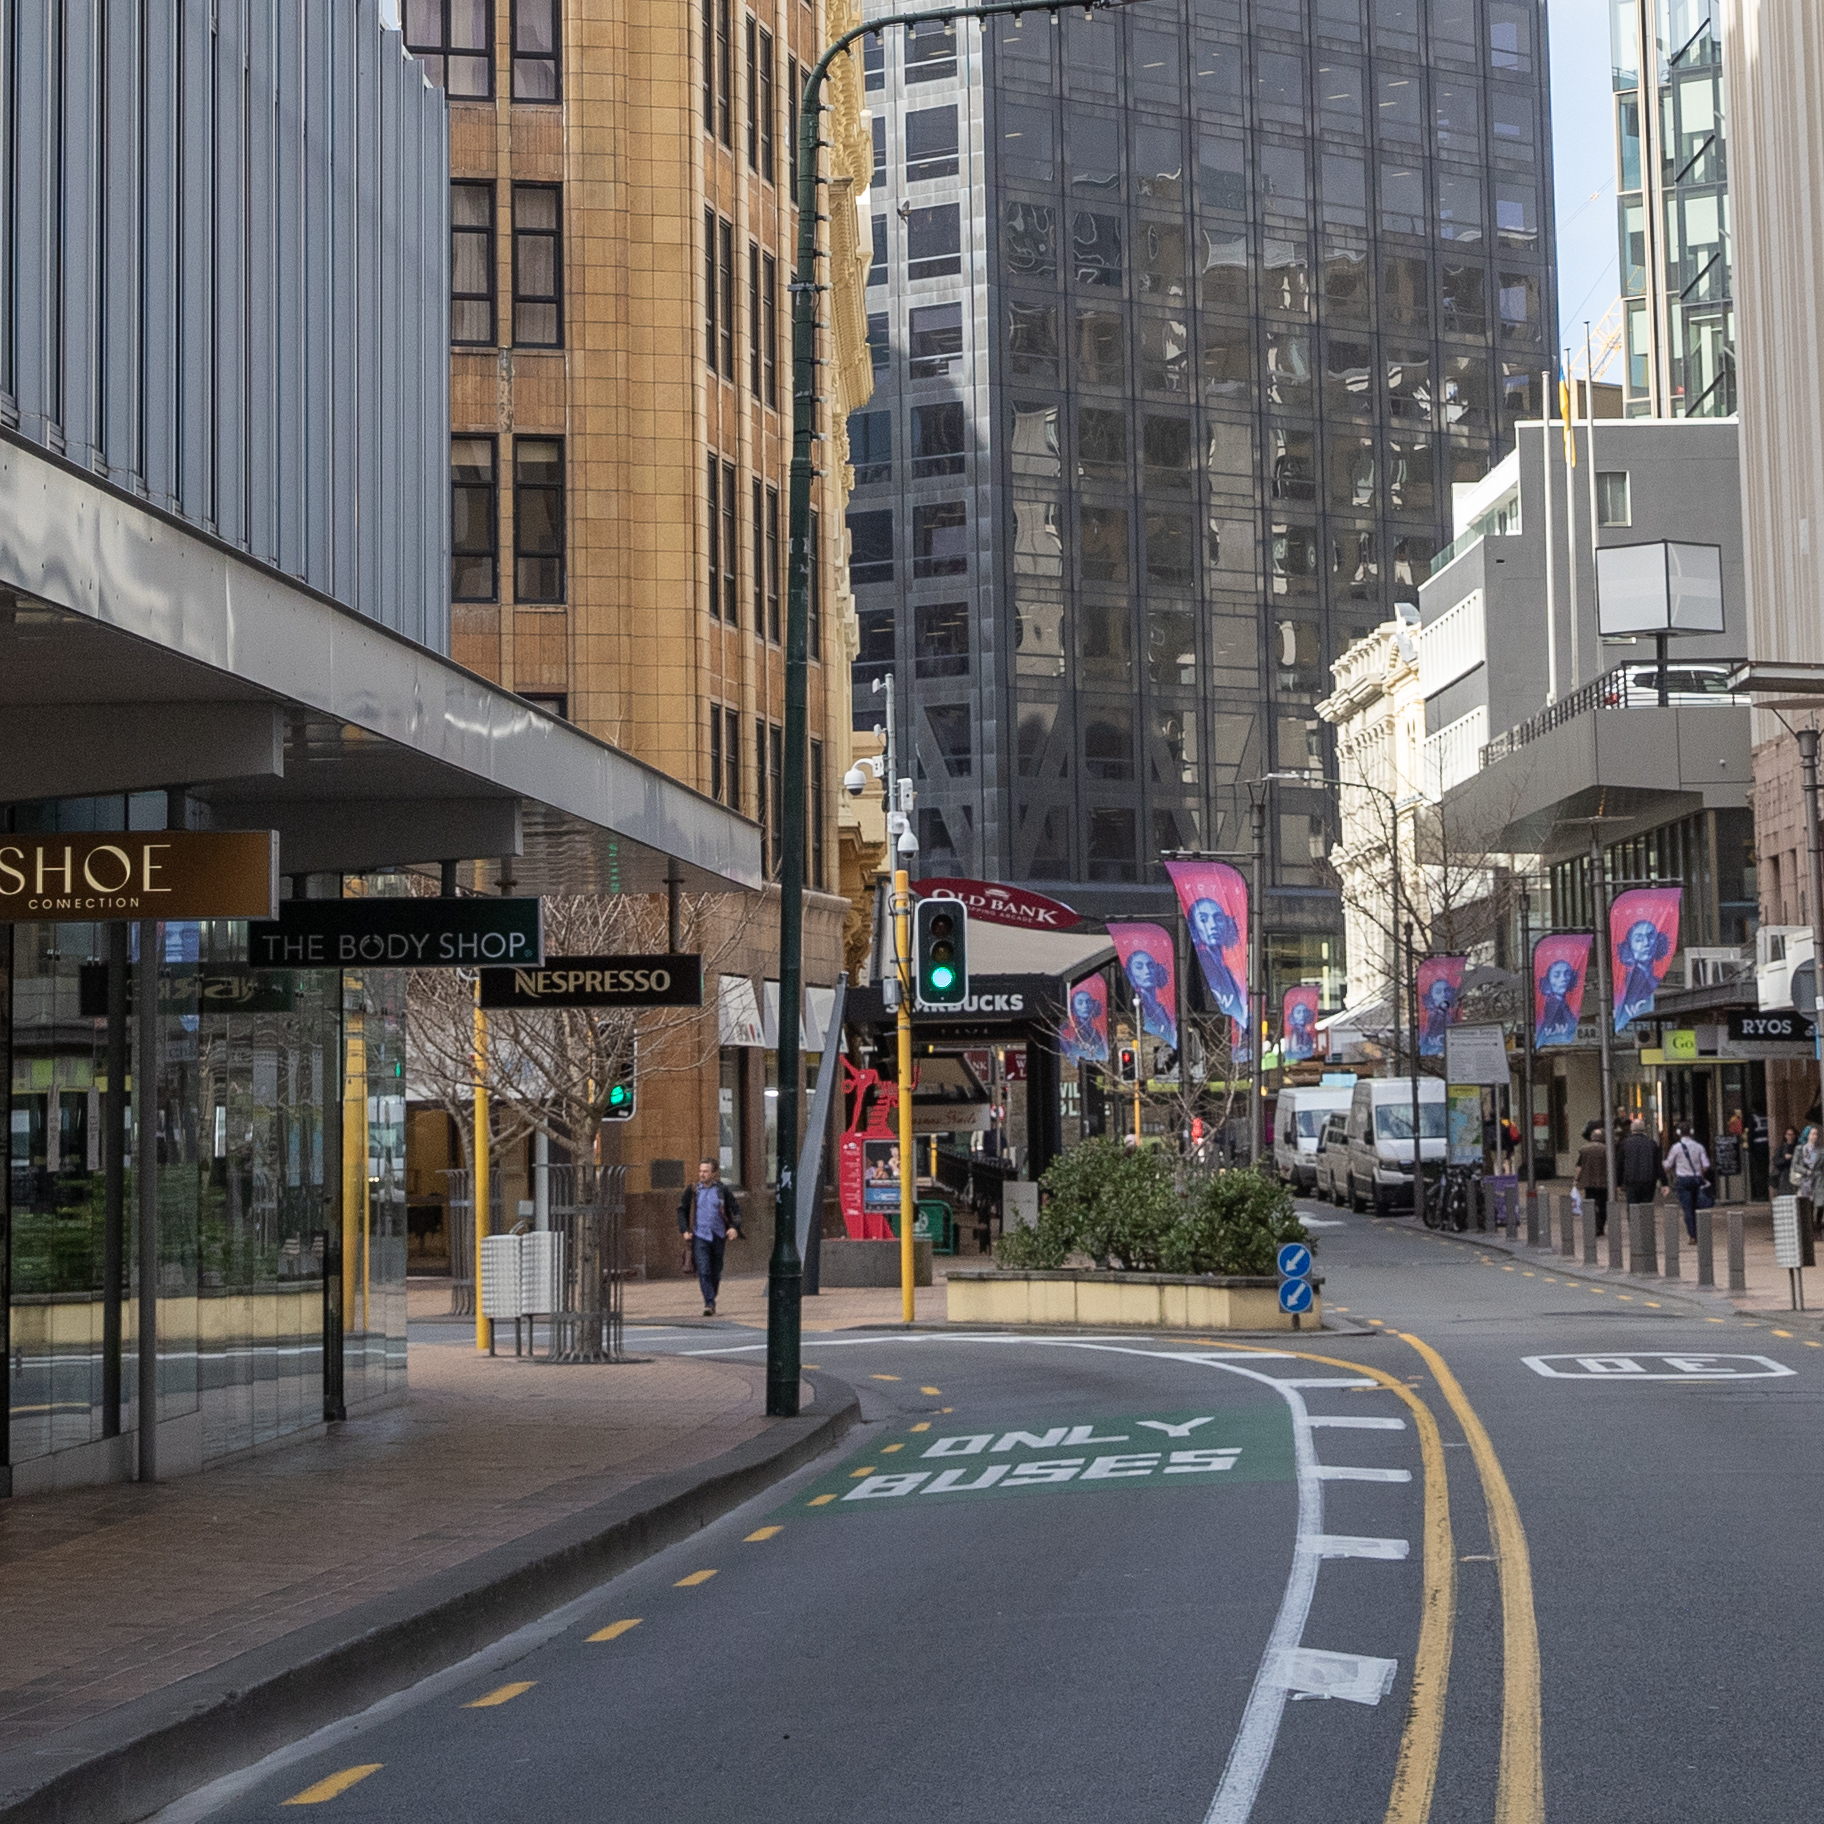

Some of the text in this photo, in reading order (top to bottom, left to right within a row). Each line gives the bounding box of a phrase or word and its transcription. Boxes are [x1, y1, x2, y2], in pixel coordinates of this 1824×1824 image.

[27, 896, 140, 910] CONNECTION
[990, 895, 1059, 925] BANK
[262, 934, 324, 961] THE
[339, 933, 430, 961] BODY
[513, 968, 671, 998] NESPRESSO
[1741, 1019, 1793, 1035] RYOS
[919, 1416, 1215, 1459] ONLY
[840, 1447, 1243, 1502] BUSES
